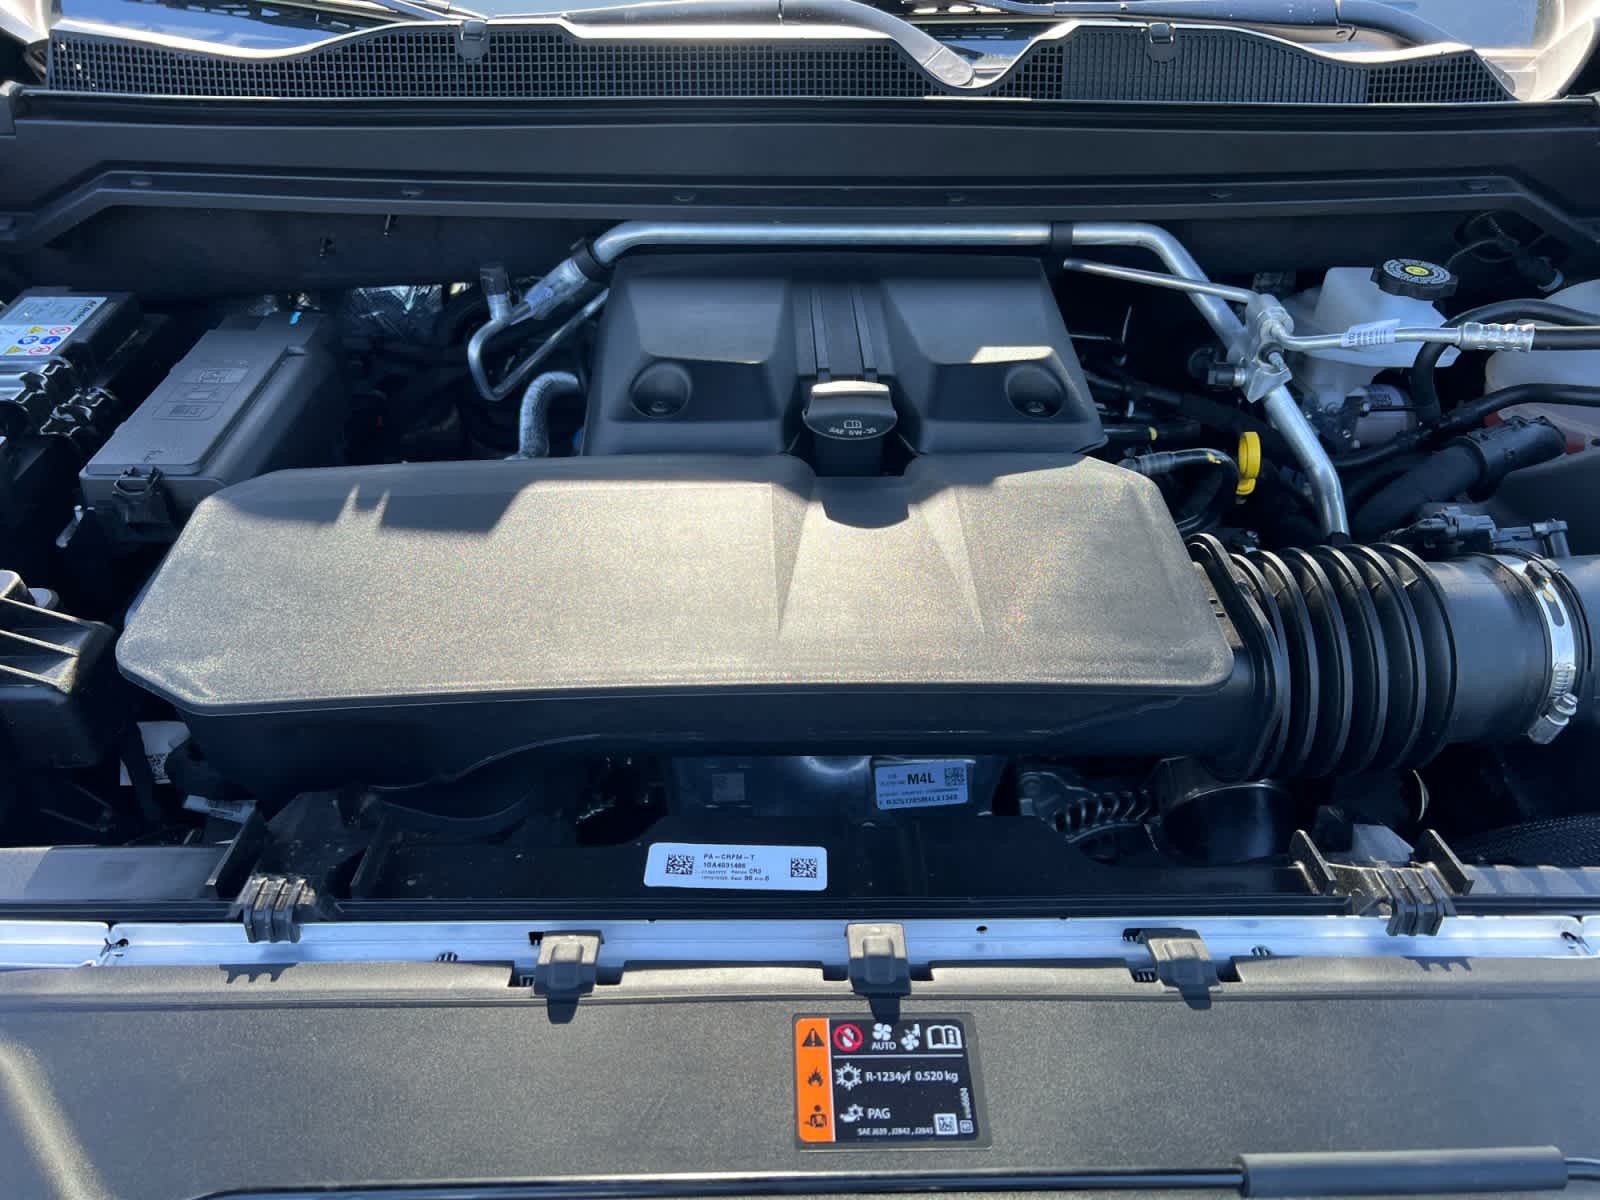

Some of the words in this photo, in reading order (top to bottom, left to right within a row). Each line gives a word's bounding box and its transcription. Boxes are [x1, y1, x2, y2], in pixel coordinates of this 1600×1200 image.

[907, 772, 936, 785] M4L
[871, 1042, 897, 1050] AUTO
[865, 1071, 911, 1083] R-1234yf
[915, 1071, 943, 1081] 0.520
[945, 1071, 958, 1083] kg
[867, 1108, 891, 1120] PAG
